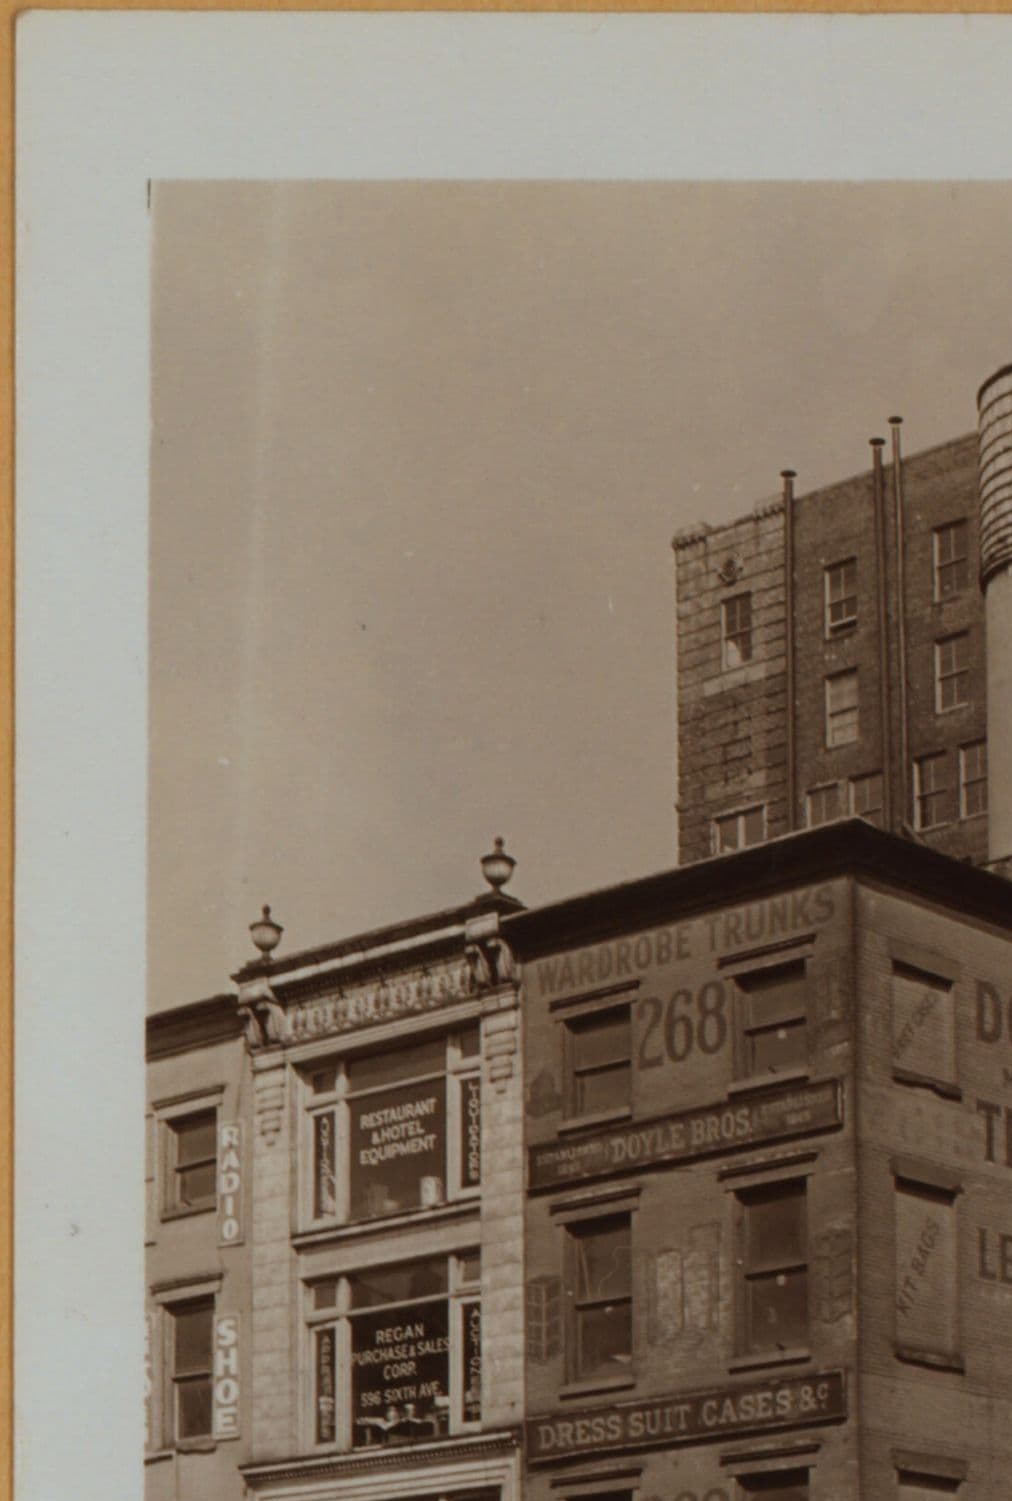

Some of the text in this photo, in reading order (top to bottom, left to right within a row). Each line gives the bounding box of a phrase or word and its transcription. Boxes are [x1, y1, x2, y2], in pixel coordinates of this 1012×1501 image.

[536, 885, 836, 996] WARDROBE TRUNKS
[638, 981, 728, 1070] 268
[360, 1097, 437, 1130] RESTAURANT
[380, 1120, 425, 1140] HOTEL
[360, 1134, 438, 1167] EQUIPMENT
[610, 1122, 685, 1164] DOYLE
[219, 1124, 240, 1241] RADIO
[375, 1322, 425, 1345] REGAN
[417, 1336, 450, 1357] SALES
[216, 1319, 240, 1438] SHOE
[384, 1385, 417, 1404] SIXTH
[539, 1417, 623, 1450] DRESS
[629, 1404, 692, 1440] SUIT
[702, 1388, 796, 1427] CASES
